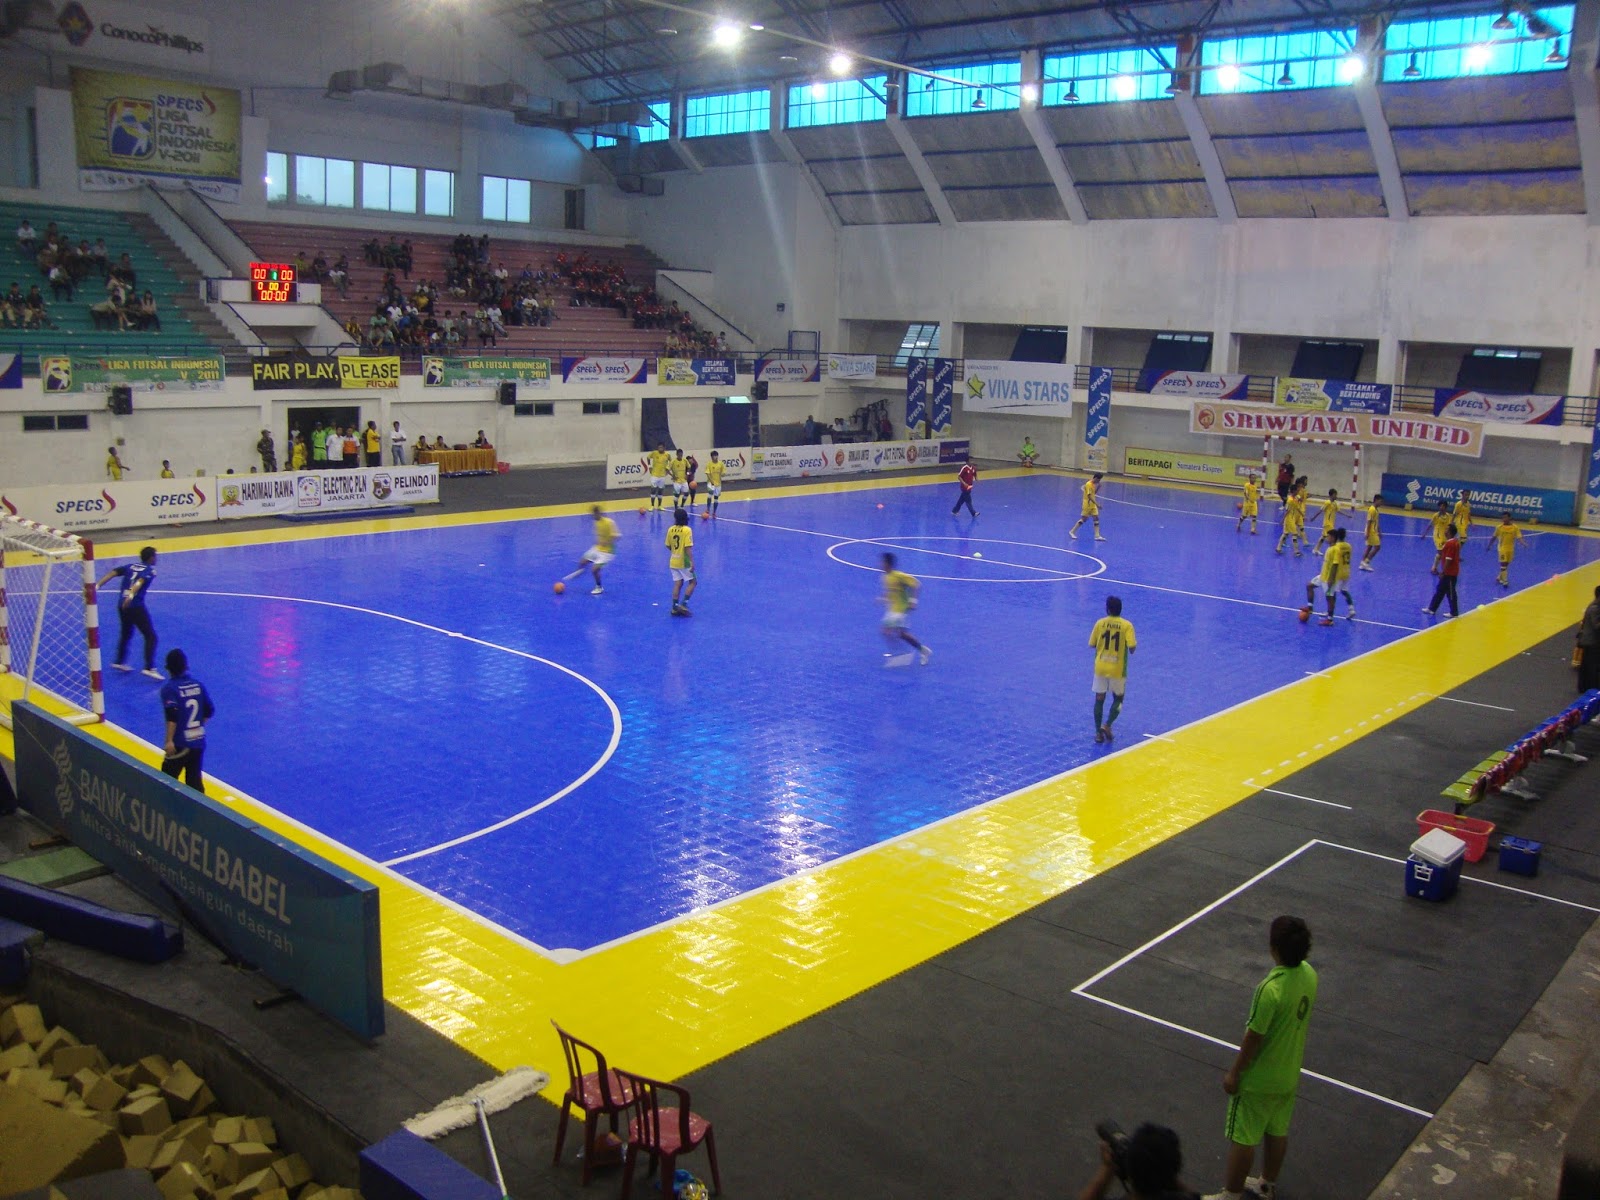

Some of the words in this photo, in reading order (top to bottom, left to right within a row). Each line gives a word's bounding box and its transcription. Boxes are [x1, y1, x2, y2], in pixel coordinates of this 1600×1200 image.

[101, 23, 204, 54] ConocoPhillips
[156, 94, 204, 112] SPECS
[158, 108, 189, 123] LIGA
[158, 123, 214, 138] FUTSAL
[158, 135, 237, 153] INDONESIA
[254, 269, 266, 279] 00
[281, 270, 293, 280] 00
[261, 290, 287, 301] 00:00
[108, 360, 130, 369] LIGA
[133, 360, 167, 369] FUTSAL
[171, 360, 220, 369] INDONESIA
[253, 363, 291, 380] FAIR
[295, 362, 338, 381] PLAY,
[341, 363, 398, 379] PLEASE
[468, 361, 484, 369] LIGA
[486, 361, 510, 369] FUTSAL
[855, 362, 875, 373] STARS
[909, 362, 924, 380] SPECS
[180, 371, 187, 380] V
[197, 371, 220, 380] 2011
[935, 365, 949, 382] SPECS
[366, 380, 398, 388] FUTSAL
[1090, 373, 1107, 391] SPECS
[1345, 383, 1376, 392] SELAMAT
[909, 384, 923, 401] SPECS
[934, 387, 949, 404] SPECS
[988, 378, 1019, 400] VIVA
[1023, 380, 1069, 402] STARS
[908, 405, 922, 422] SPECS
[1088, 397, 1105, 415] SPECS
[1455, 400, 1483, 409] SPECS
[1496, 404, 1527, 412] SPECS
[934, 409, 948, 425] SPECS
[1087, 420, 1104, 438] SPECS
[1223, 411, 1358, 434] SRIWIJAYA
[1371, 418, 1471, 446] UNITED
[615, 464, 641, 475] SPECS
[722, 459, 740, 468] PECS
[799, 458, 822, 468] SPECS
[1128, 457, 1172, 469] BERITAPAGI
[1177, 462, 1201, 471] Sumatera
[323, 476, 353, 495] ELECTRIC
[355, 475, 367, 493] PLN
[394, 475, 428, 489] PELINDO
[431, 474, 437, 486] II
[241, 481, 273, 501] HARIMAU
[274, 479, 294, 498] RAWA
[327, 493, 366, 502] JAKARTA
[1424, 486, 1454, 499] BANK
[56, 499, 104, 513] SPECS
[151, 493, 194, 507] SPECS
[673, 535, 680, 550] 3
[1101, 630, 1120, 652] 11
[185, 698, 201, 728] 2
[80, 769, 127, 826] BANK
[130, 798, 292, 925] SUMSELBABEL
[237, 910, 294, 955] daerah
